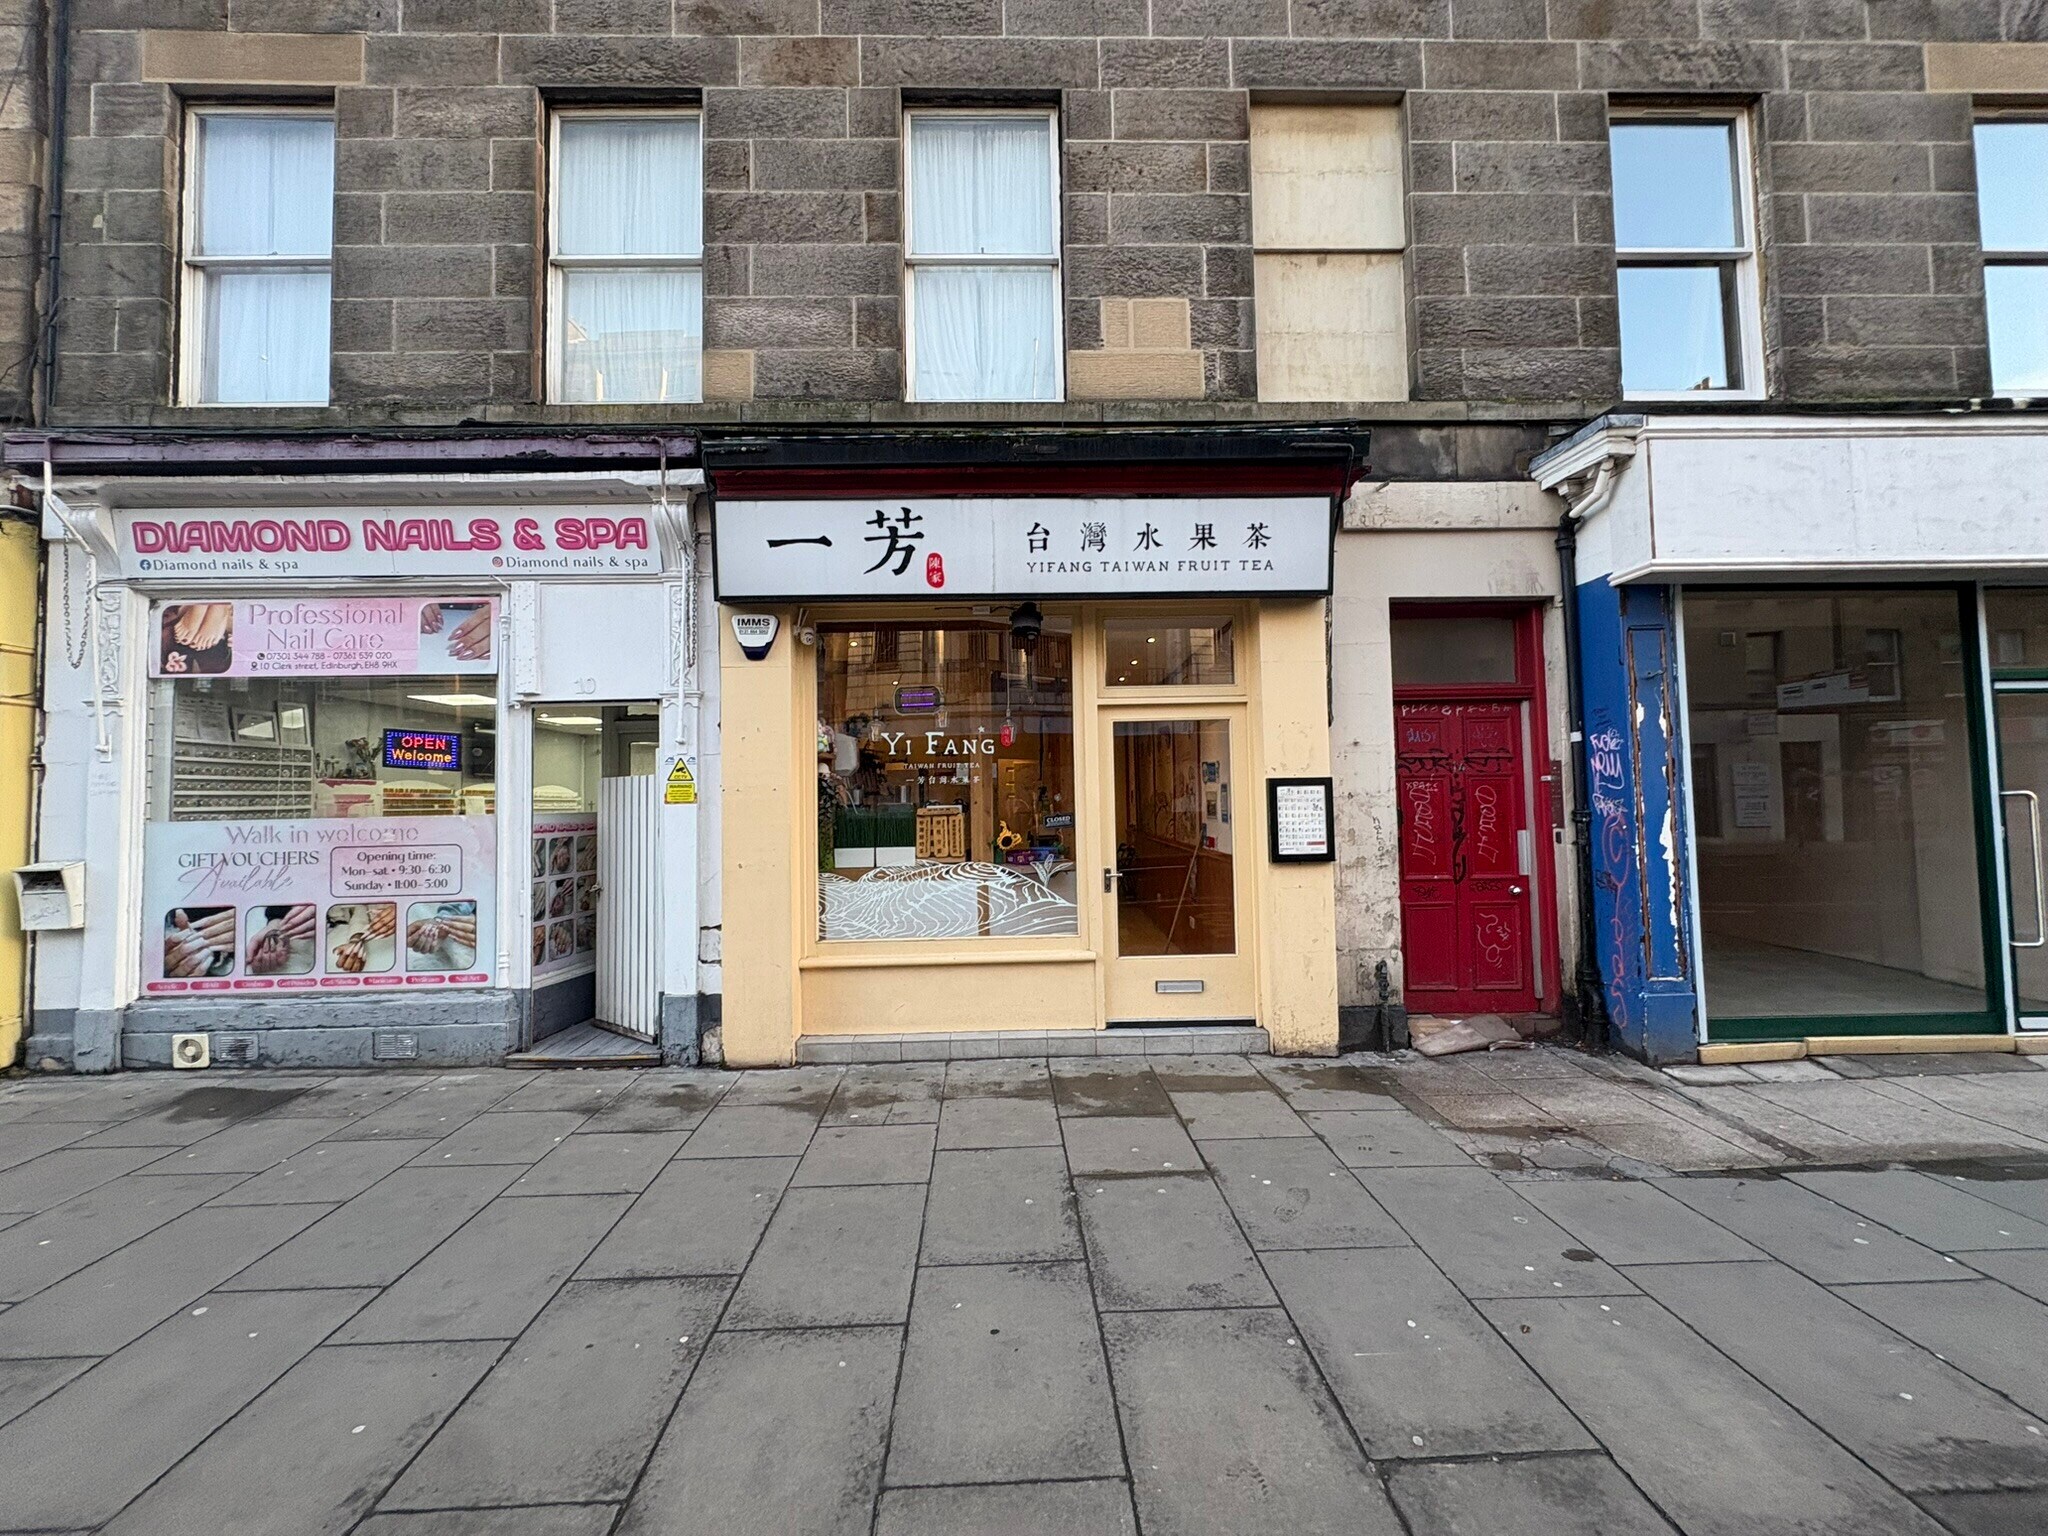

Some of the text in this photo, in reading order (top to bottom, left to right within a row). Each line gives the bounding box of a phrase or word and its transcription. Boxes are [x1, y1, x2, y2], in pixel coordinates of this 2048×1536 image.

[132, 518, 648, 553] DIAMOND NAILS & SPA
[767, 507, 924, 576] 一芳
[1026, 522, 1273, 553] 台灣水果茶
[153, 558, 299, 573] Diamond nails & spa
[506, 556, 648, 570] Diamond nails & spa
[1026, 559, 1274, 573] YIFANG TAIWAN FRUIT TEA
[250, 603, 403, 625] Professional
[737, 618, 770, 626] IMMS
[267, 627, 384, 650] Nail Care
[401, 736, 446, 750] OPEN
[391, 748, 452, 763] Welcome
[225, 825, 282, 844] Walk
[290, 825, 308, 843] in
[178, 850, 320, 868] GIFT VOUCHERS
[357, 850, 437, 864] Opening time:
[344, 880, 384, 892] Sunday
